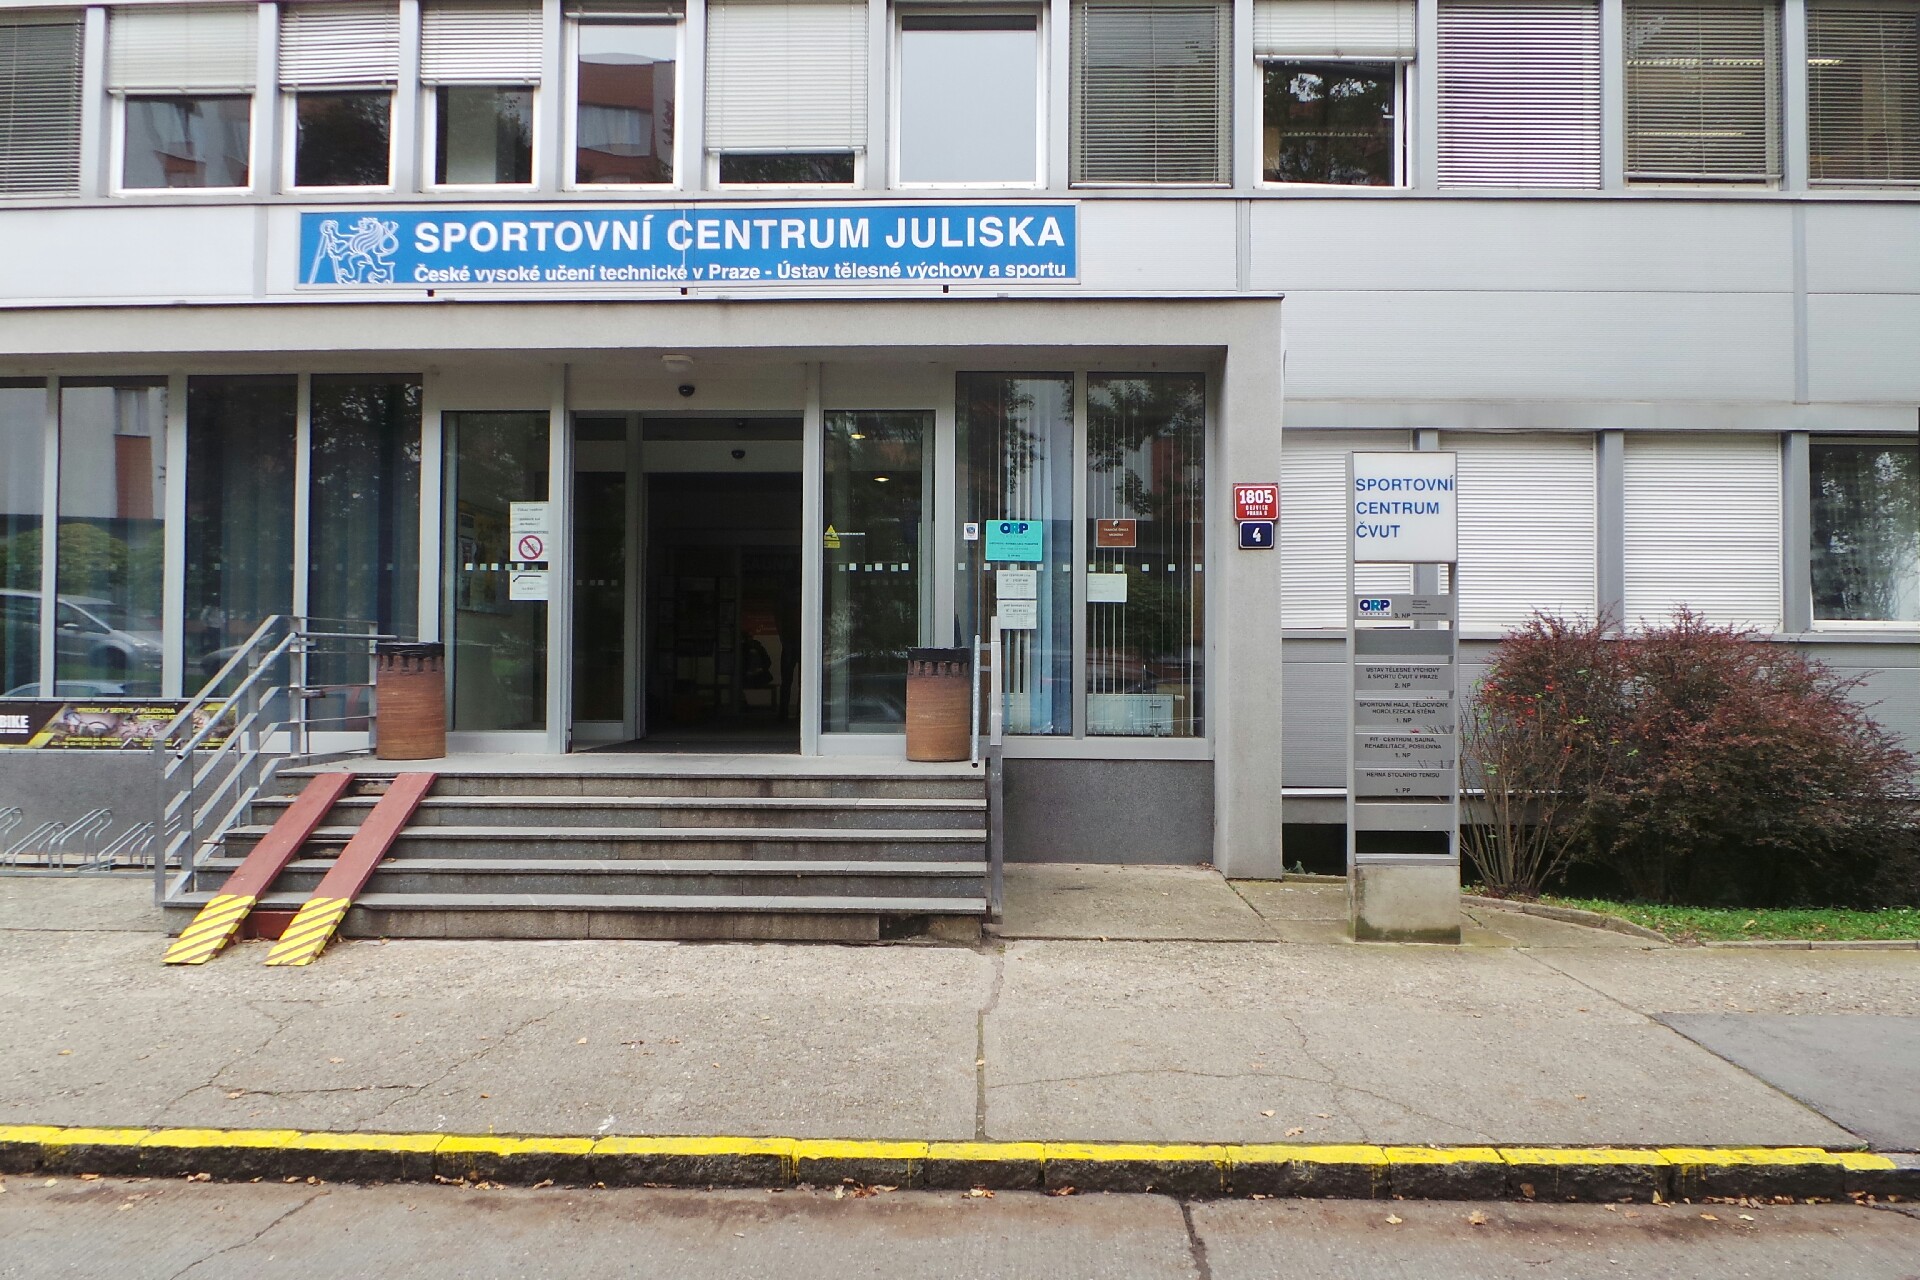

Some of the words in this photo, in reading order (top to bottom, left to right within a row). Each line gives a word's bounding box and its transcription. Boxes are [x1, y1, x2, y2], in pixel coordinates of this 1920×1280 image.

[414, 215, 652, 253] SPORTOVNÍ
[667, 217, 870, 251] CENTRUM
[885, 216, 1066, 249] JULISKA
[414, 263, 471, 283] České
[474, 264, 541, 285] vysoké
[545, 263, 596, 282] učení
[600, 262, 688, 281] technické
[692, 267, 704, 280] v
[708, 264, 761, 281] Praze
[777, 260, 829, 280] Ústav
[834, 261, 902, 279] tělesné
[907, 261, 985, 281] výchovy
[989, 265, 1001, 278] a
[1005, 262, 1067, 281] sportu
[1355, 475, 1454, 491] SPORTOVNÍ
[1239, 489, 1274, 505] 1805
[1355, 501, 1440, 515] CENTRUM
[1000, 522, 1029, 535] ORP
[1252, 527, 1262, 543] 4
[1355, 520, 1401, 538] ČVUT
[1359, 599, 1391, 612] ORP
